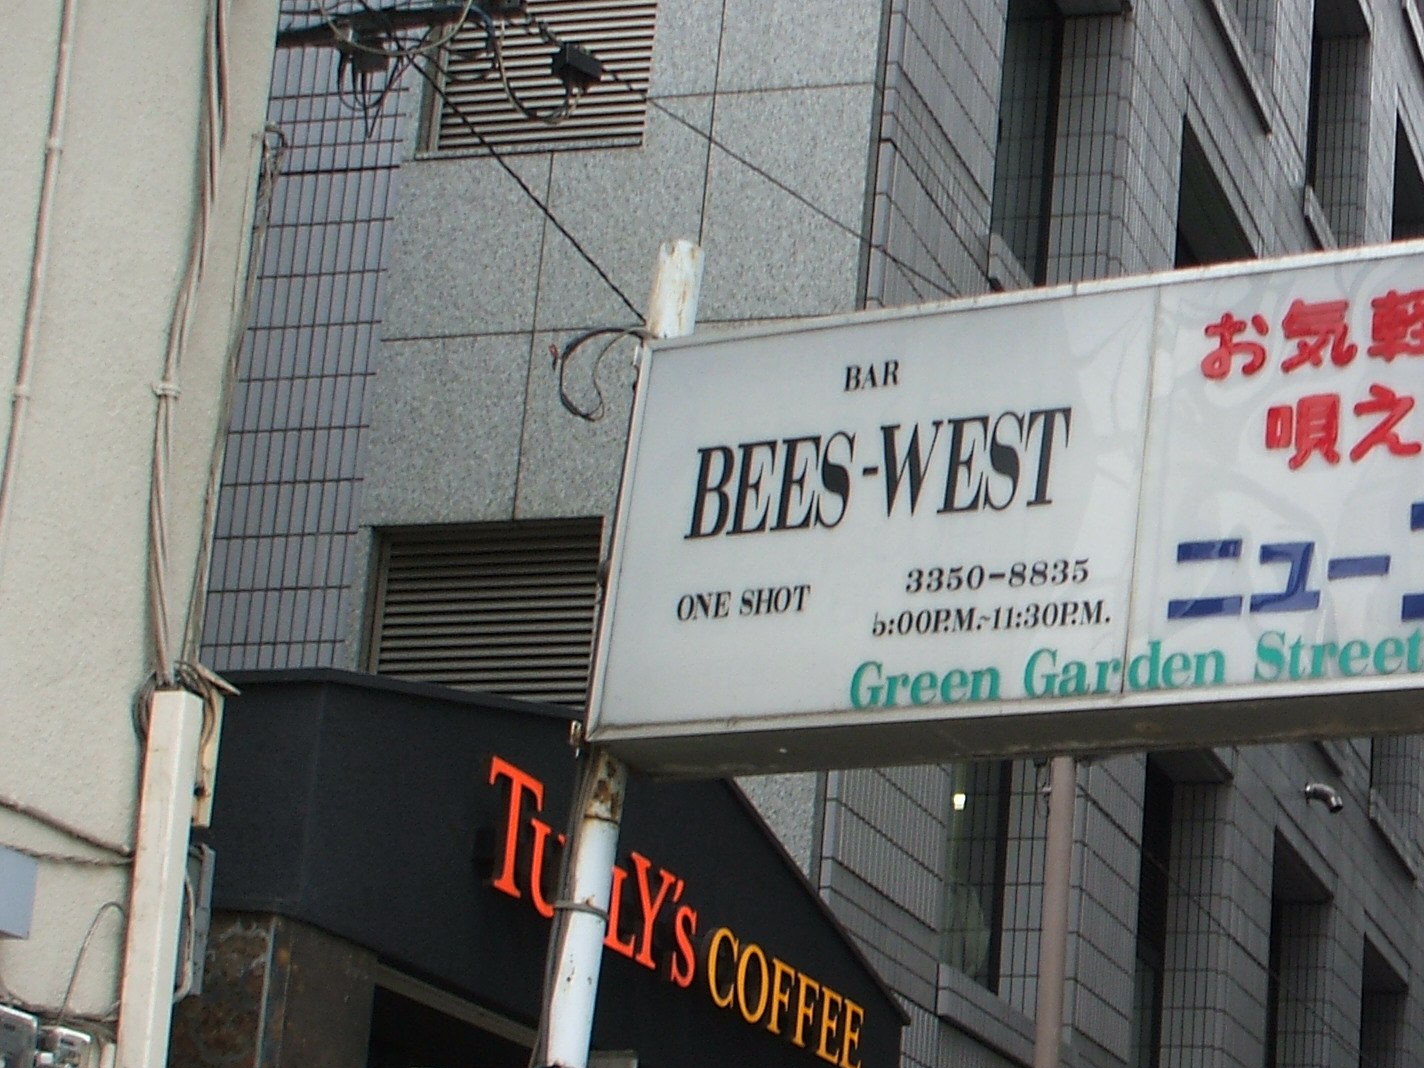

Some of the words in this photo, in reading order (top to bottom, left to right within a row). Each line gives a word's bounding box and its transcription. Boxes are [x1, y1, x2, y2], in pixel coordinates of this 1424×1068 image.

[844, 360, 900, 392] BAR
[684, 407, 1072, 540] BEES-WEST
[677, 593, 730, 622] ONE
[739, 585, 811, 616] SHOT
[905, 558, 1090, 594] 3350-8835
[850, 660, 1001, 710] Green
[1024, 640, 1225, 699] Garden
[1253, 628, 1424, 682] Street
[490, 756, 697, 987] TULY'S
